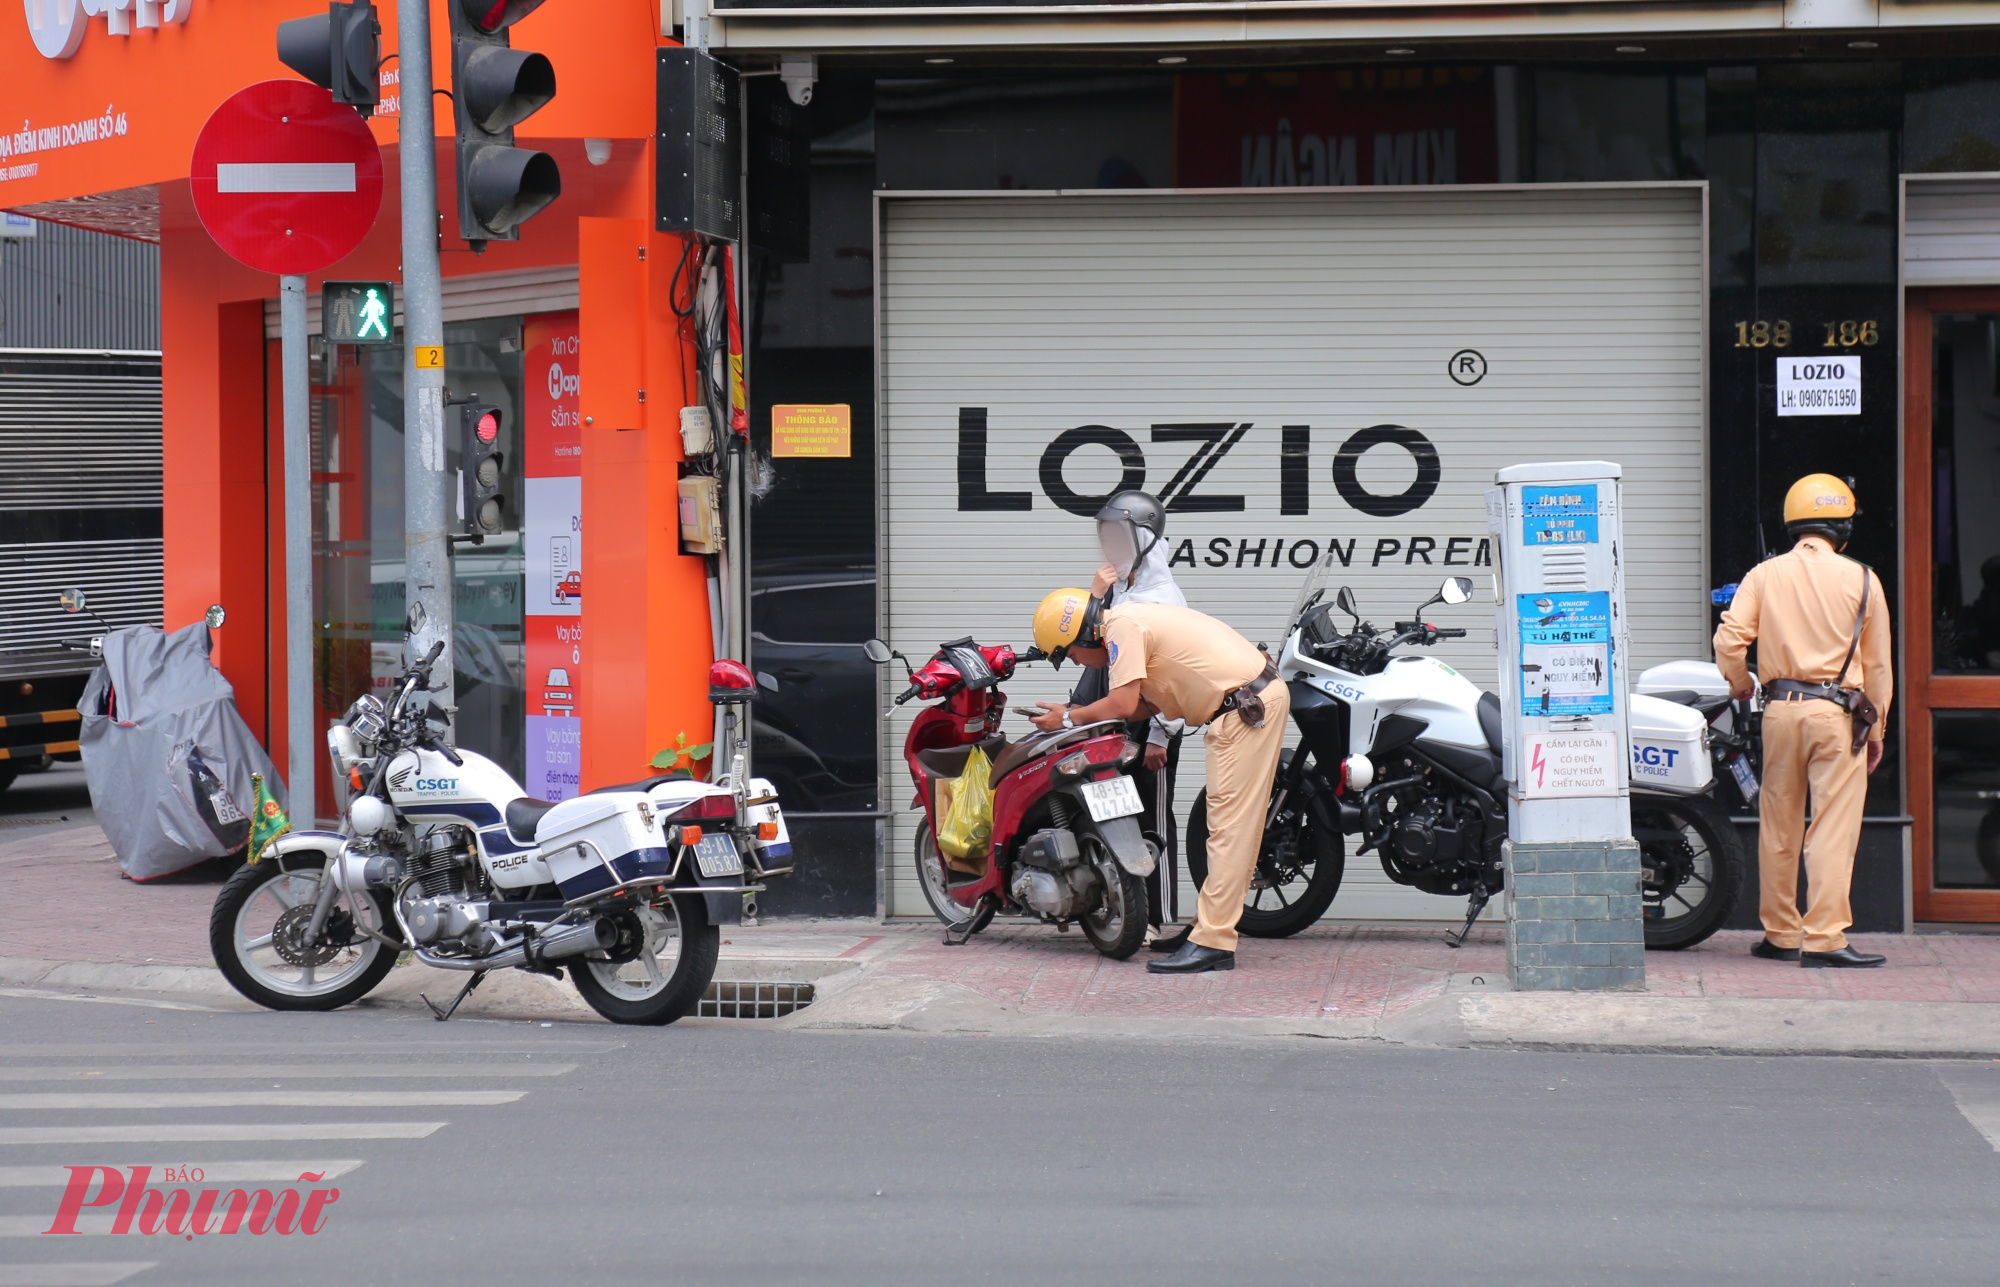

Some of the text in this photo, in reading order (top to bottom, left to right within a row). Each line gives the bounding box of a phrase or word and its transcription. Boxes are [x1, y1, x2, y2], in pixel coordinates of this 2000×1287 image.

[13, 118, 37, 155] ĐIỂM
[38, 126, 61, 151] KINH
[62, 118, 98, 147] DOANH
[99, 103, 114, 140] SỐ
[114, 112, 127, 136] 46
[1734, 320, 1879, 347] 188 186
[552, 337, 566, 355] Xin
[430, 349, 438, 365] 2
[1792, 363, 1845, 380] LOZIO
[1781, 389, 1857, 408] LH: 0908761950
[552, 405, 570, 427] Sẵn
[785, 414, 838, 424] THÔNG BÁO
[554, 446, 572, 457] Hotline
[957, 406, 1442, 517] LOZIO
[1815, 495, 1848, 506] CSGT
[1168, 537, 1356, 568] ASHION
[1059, 597, 1077, 633] CSGT
[556, 624, 571, 644] Vay
[1530, 630, 1547, 640] TỦ
[1572, 629, 1597, 640] THẾ
[572, 645, 580, 665] Ô
[1552, 655, 1566, 667] CÓ
[1544, 672, 1568, 683] NGUY
[546, 727, 561, 747] Vay
[1546, 738, 1566, 749] CẤM
[1568, 740, 1581, 750] LẠI
[1583, 736, 1602, 748] GẦN
[557, 746, 571, 764] sản
[1560, 754, 1595, 766] CÓ ĐIỆN
[546, 770, 561, 787] điện
[1553, 768, 1577, 776] NGUY
[1643, 765, 1669, 777] POLICE
[416, 778, 460, 791] CSGT
[1091, 779, 1128, 800] 48-E1
[1551, 777, 1574, 788] CHẾT
[546, 787, 562, 802] ipad
[1093, 795, 1140, 819] 147.44
[492, 855, 528, 870] POLICE
[701, 854, 741, 873] 005.82
